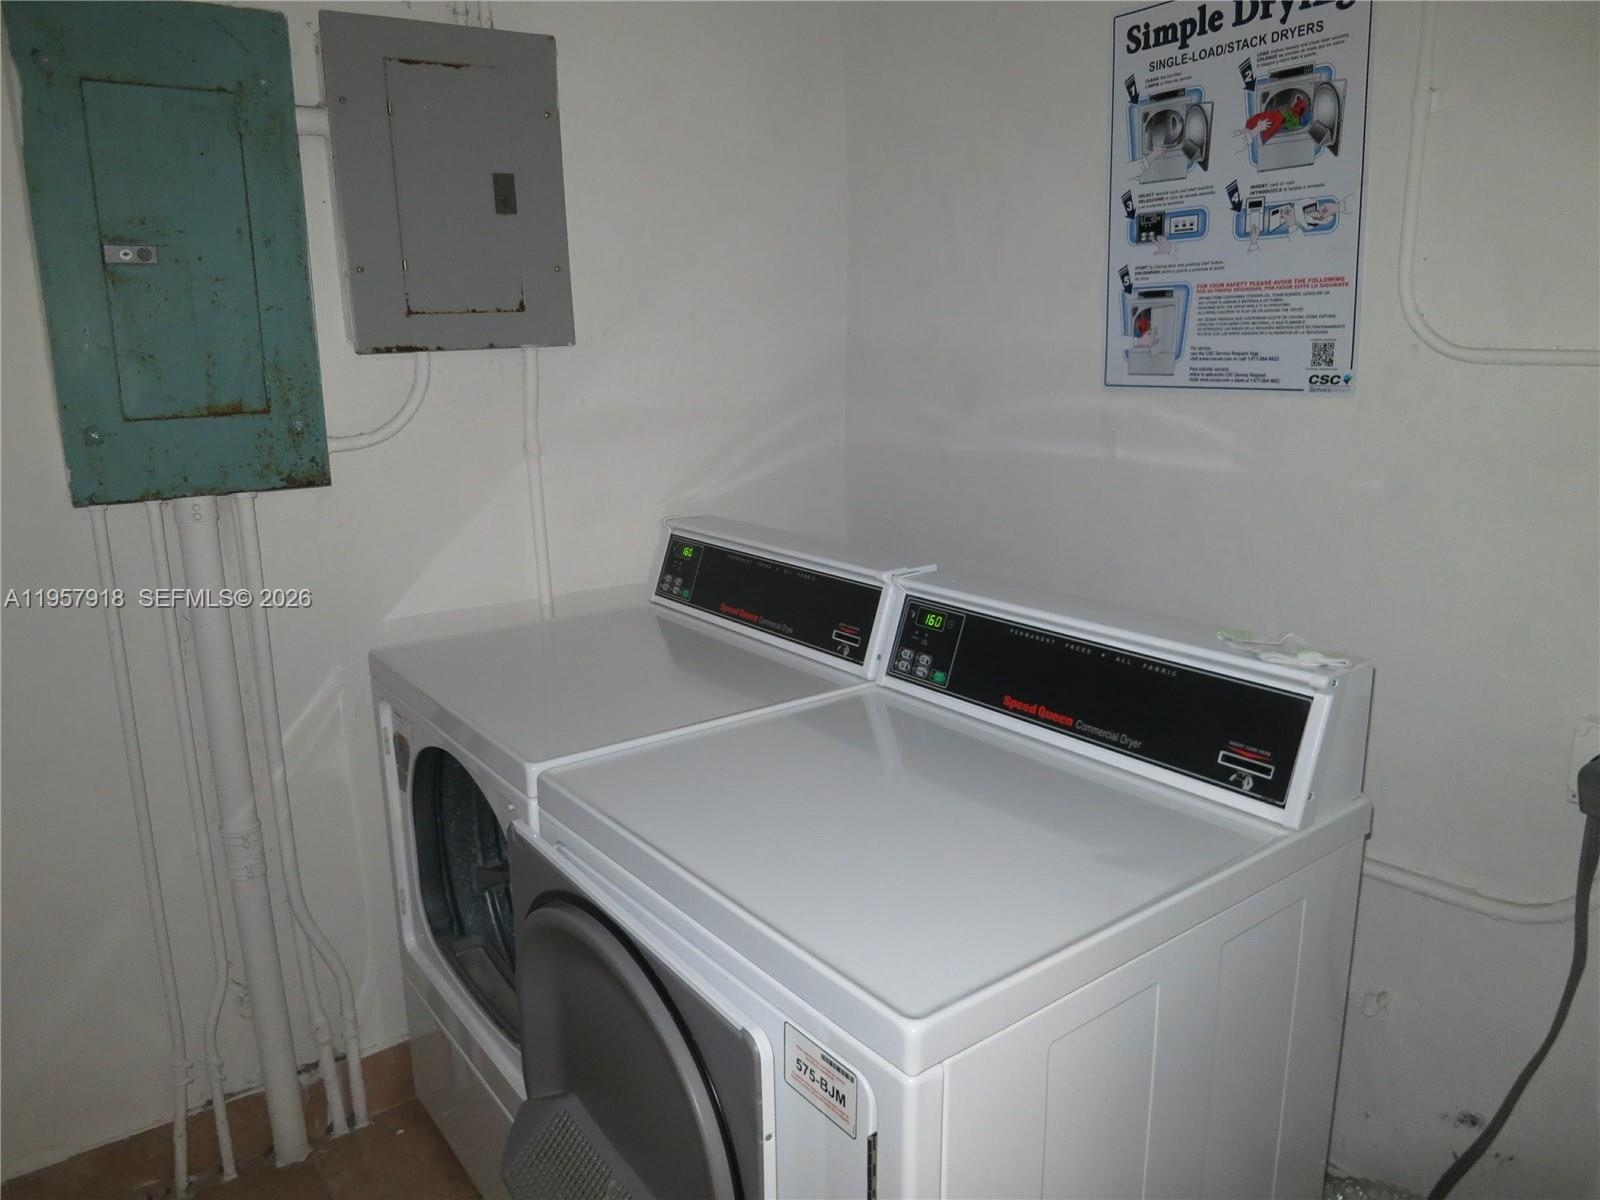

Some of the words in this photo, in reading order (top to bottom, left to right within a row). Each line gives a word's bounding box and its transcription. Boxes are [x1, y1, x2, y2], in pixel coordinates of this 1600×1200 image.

[1126, 4, 1223, 55] Simple
[1232, 0, 1355, 27] Dry
[1148, 33, 1267, 72] SINGLE-LOAD/STACK
[1271, 20, 1324, 44] DRYERS
[1244, 71, 1252, 82] 2
[1129, 86, 1136, 96] 1
[1231, 191, 1239, 203] 4
[1126, 201, 1133, 212] 3
[1123, 276, 1130, 286] 5
[1309, 374, 1341, 385] CSC
[924, 613, 942, 628] 160
[1009, 628, 1056, 645] PERMANENT
[1065, 642, 1091, 654] PRESS
[1115, 656, 1132, 665] ALL
[1142, 663, 1177, 677] FABRIC
[1002, 695, 1038, 715] Speed
[1038, 705, 1074, 726] Queen
[1075, 719, 1119, 742] Commercial
[1120, 734, 1142, 749] Dryer
[796, 1058, 846, 1108] 575-BJM
